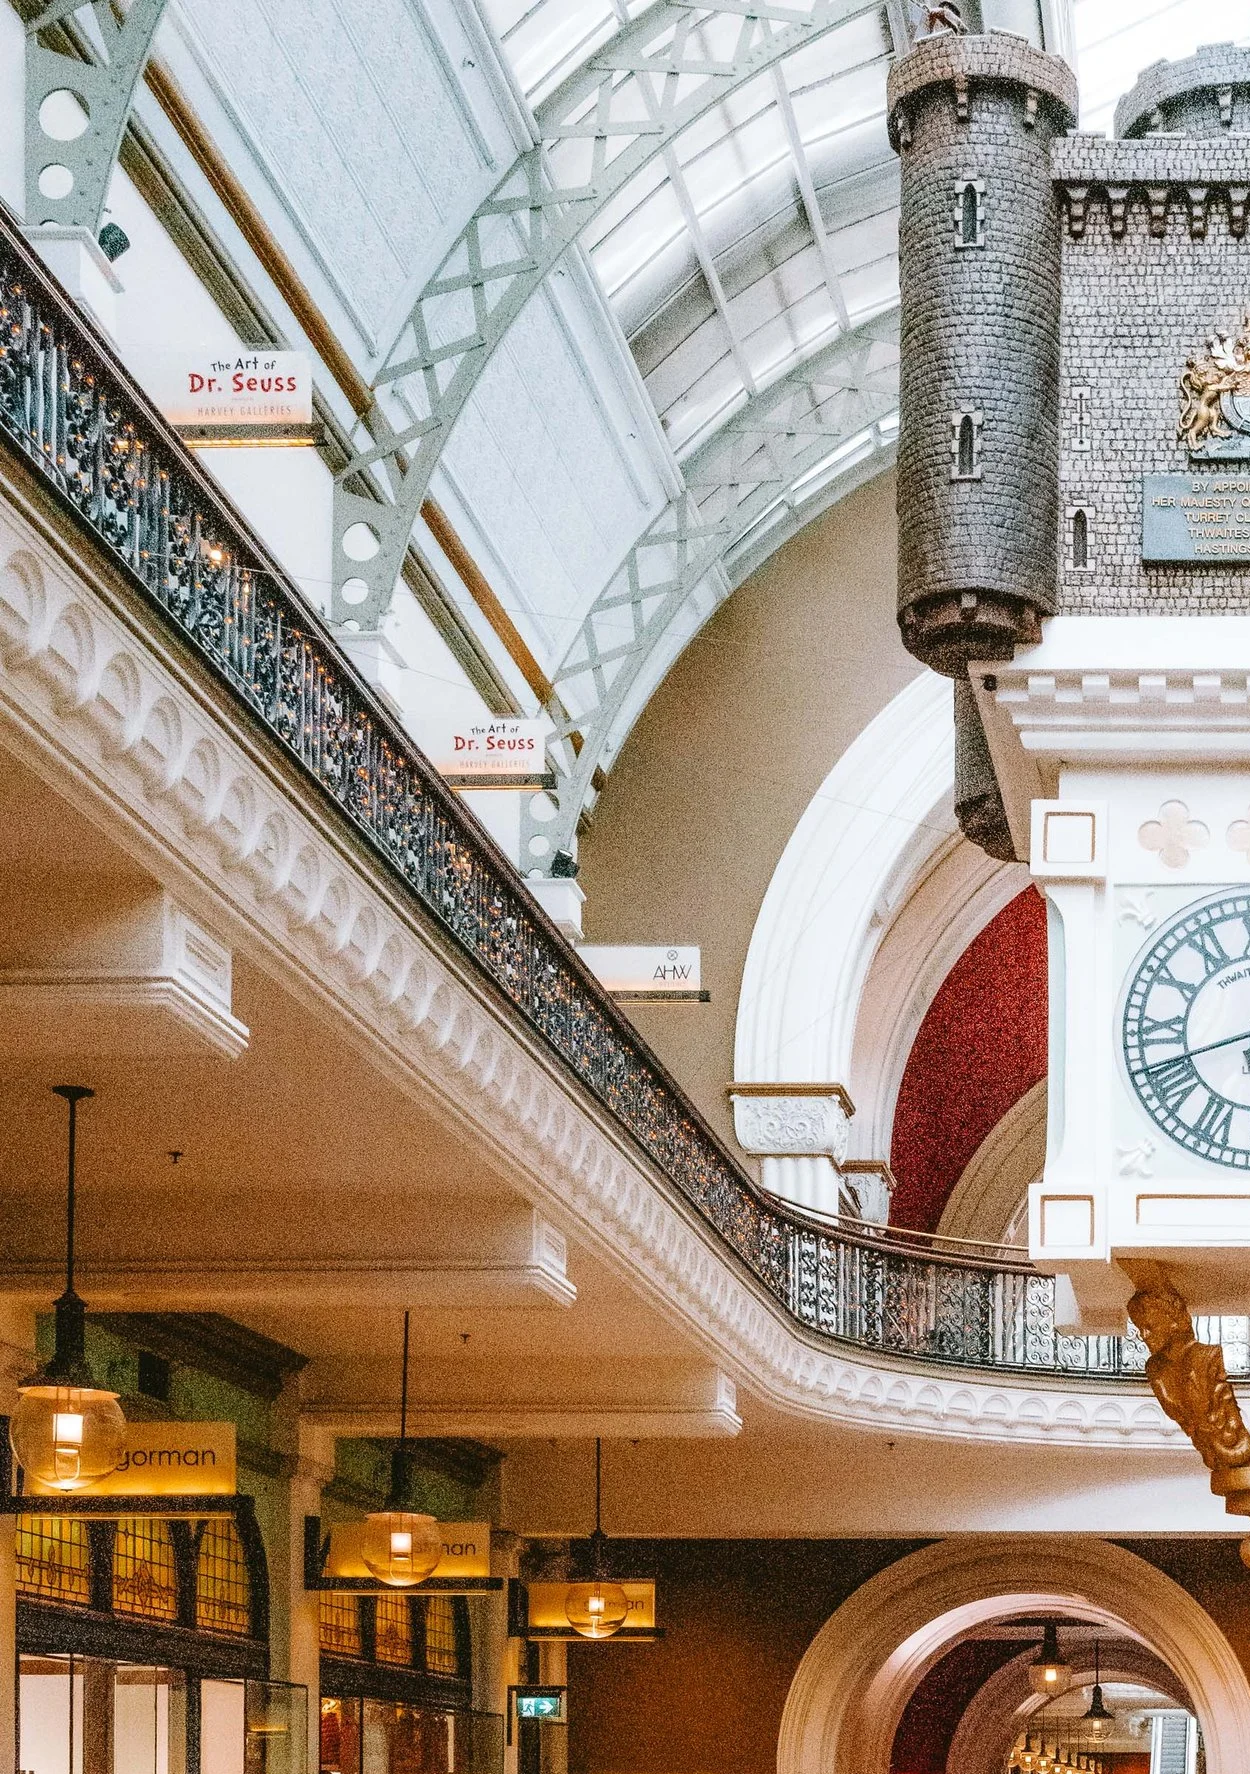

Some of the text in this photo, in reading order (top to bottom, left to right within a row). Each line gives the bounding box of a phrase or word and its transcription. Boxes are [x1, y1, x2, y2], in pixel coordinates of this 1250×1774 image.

[211, 357, 277, 372] The Art of
[188, 373, 297, 393] Dr. Seuss
[198, 405, 291, 416] HARVEY GALLERIES
[1192, 482, 1209, 493] BY
[1152, 497, 1176, 507] HER
[1181, 497, 1236, 508] MAJESTY
[1185, 512, 1231, 523] TURRET
[1188, 528, 1250, 539] THWAITES
[470, 726, 486, 735] The
[488, 723, 506, 733] Art
[454, 736, 535, 751] Dr. Seuss
